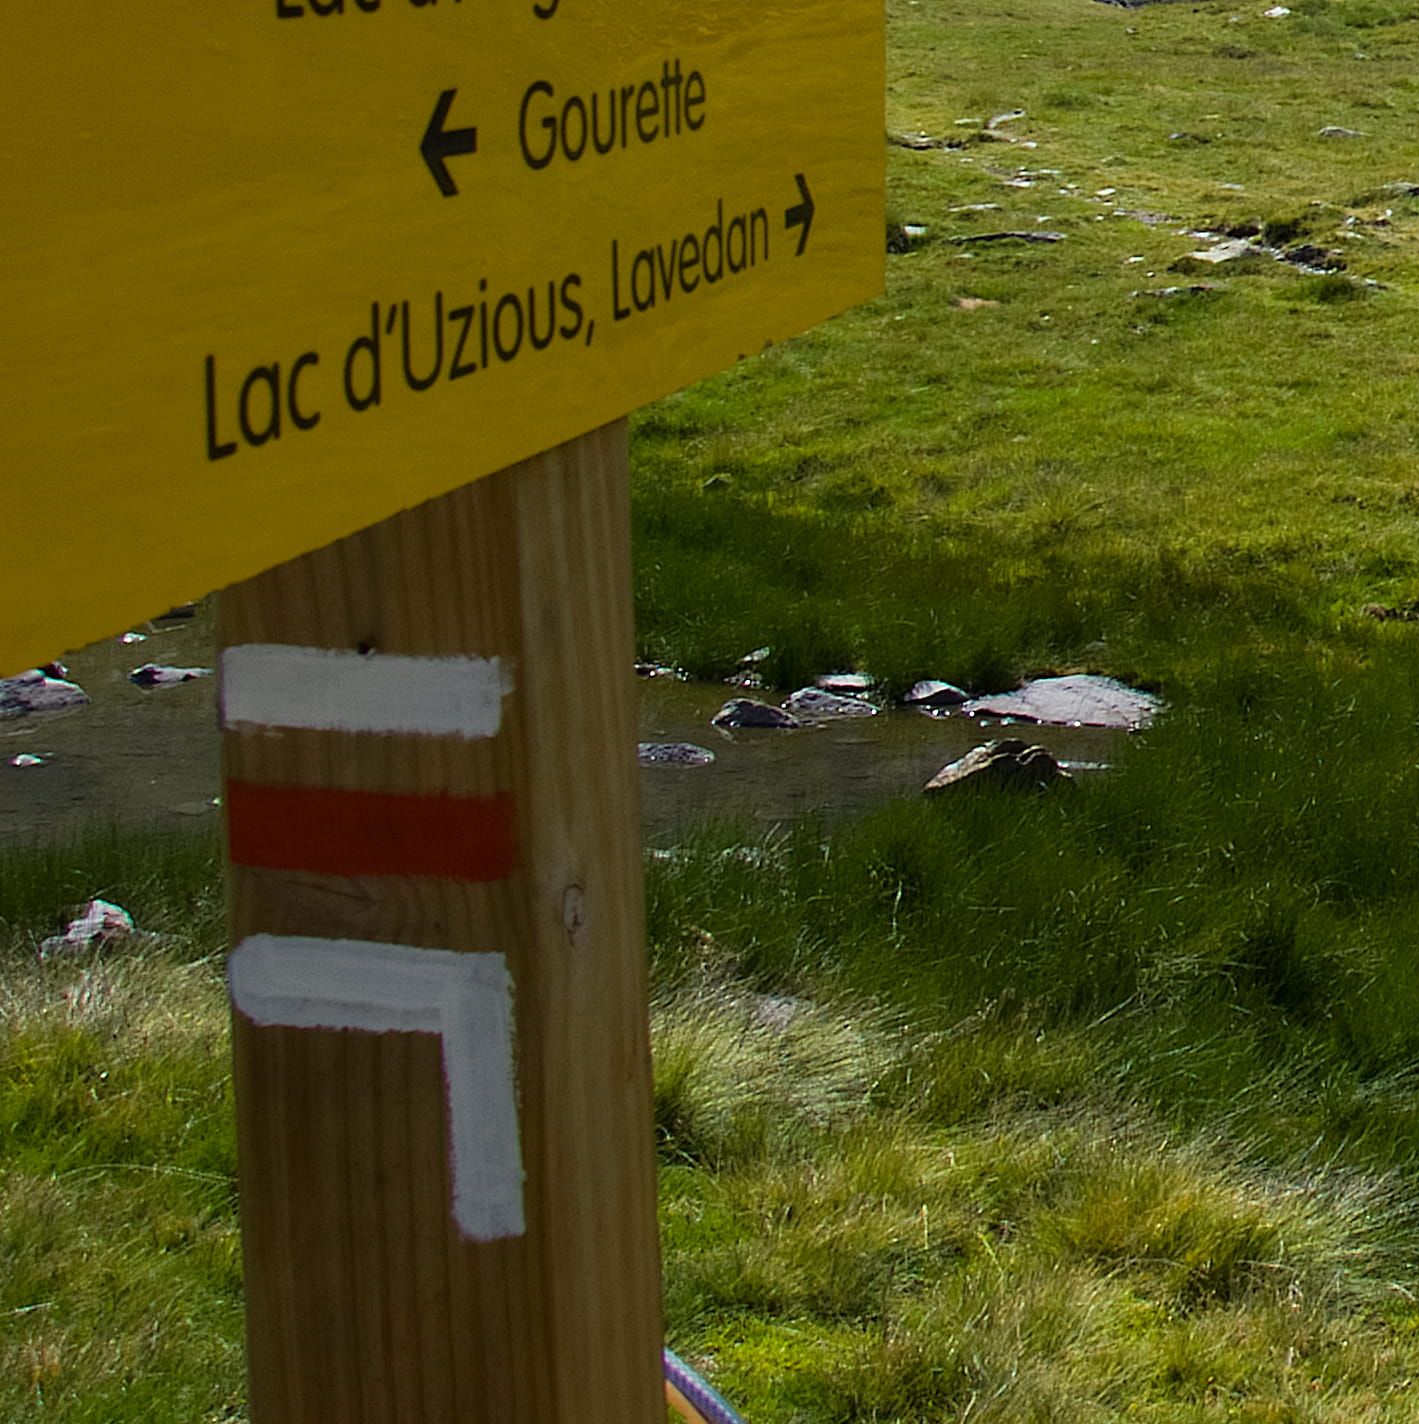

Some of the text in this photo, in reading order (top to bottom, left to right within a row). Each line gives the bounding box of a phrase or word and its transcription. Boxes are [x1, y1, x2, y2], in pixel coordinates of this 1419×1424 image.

[518, 59, 706, 171] Gourette
[205, 198, 769, 462] Lac d'Uzious, Lavedan
